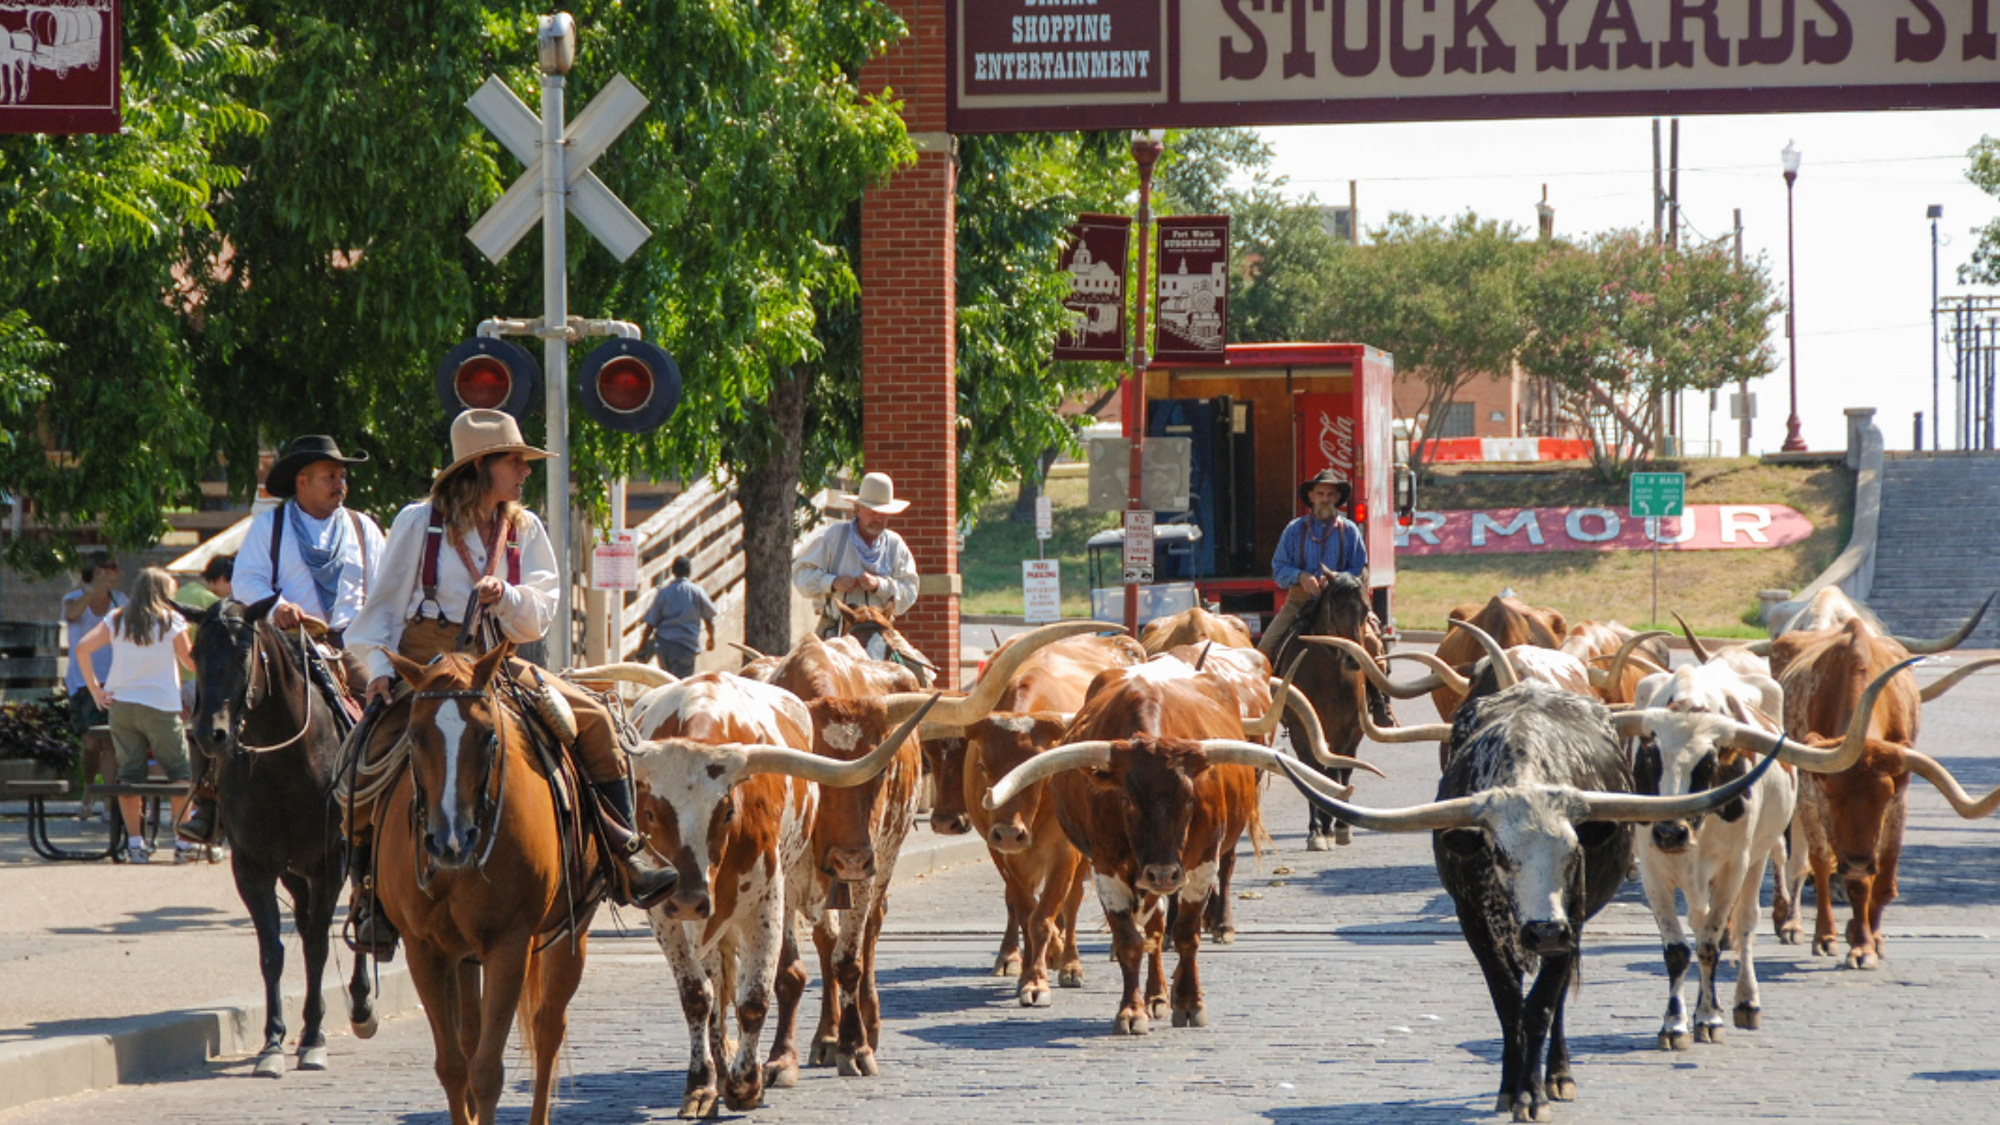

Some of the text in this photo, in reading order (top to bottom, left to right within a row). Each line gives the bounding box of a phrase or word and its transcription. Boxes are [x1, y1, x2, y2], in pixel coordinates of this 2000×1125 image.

[1012, 14, 1112, 43] SHOPPING
[1220, 0, 1854, 80] STOCKYARDS
[975, 50, 1150, 81] ENTERTAINMENT
[1394, 506, 1771, 547] RMOUR
